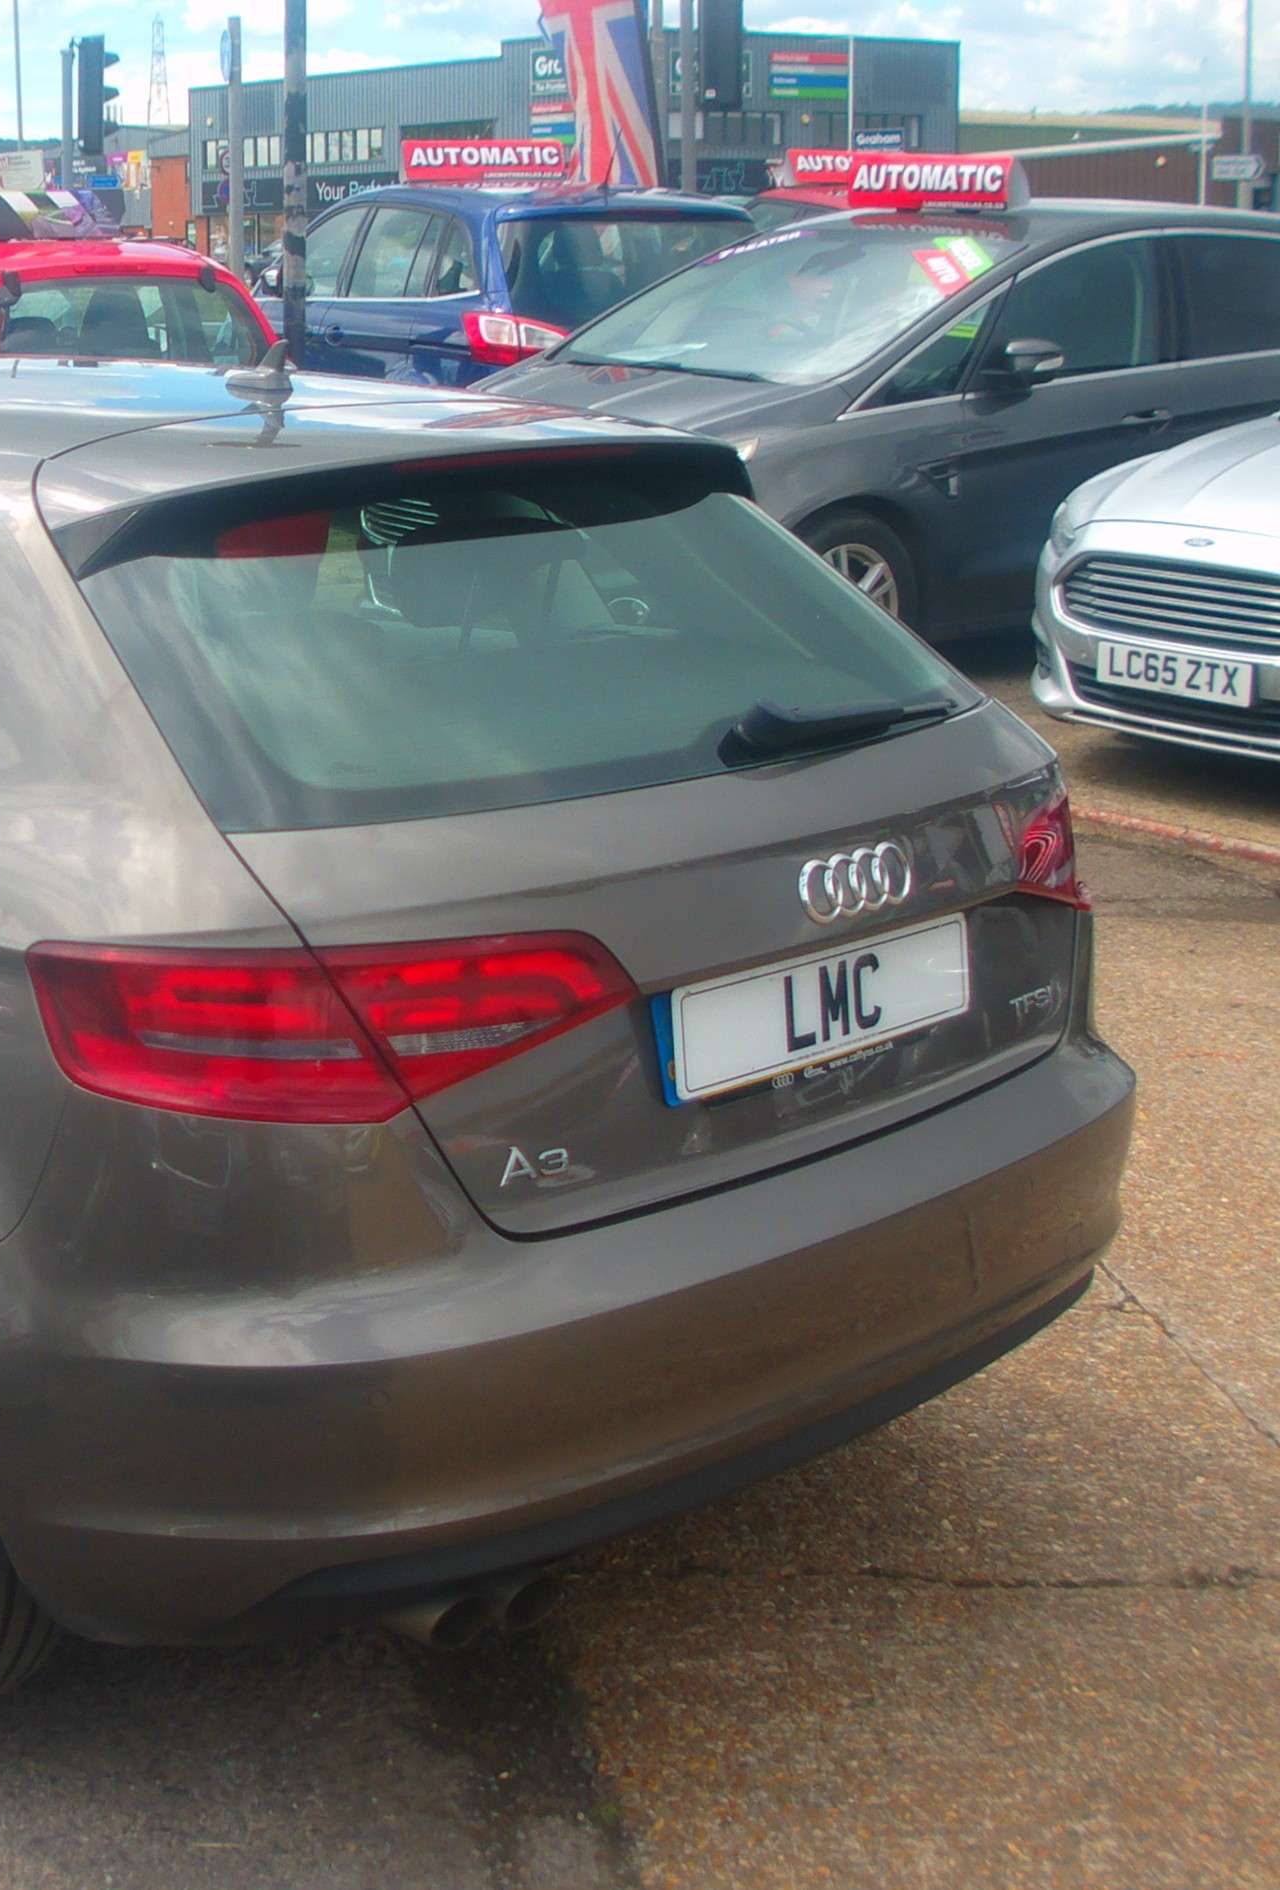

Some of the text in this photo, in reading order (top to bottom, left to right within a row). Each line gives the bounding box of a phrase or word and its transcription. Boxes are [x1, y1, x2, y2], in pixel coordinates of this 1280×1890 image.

[410, 146, 560, 167] AUTOMATIC
[797, 155, 853, 171] AUTO
[316, 181, 346, 202] Your
[852, 164, 1004, 193] AUTOMATIC
[1108, 646, 1239, 697] LC65 ZTX
[784, 952, 881, 1053] LMC
[499, 1146, 569, 1187] A3
